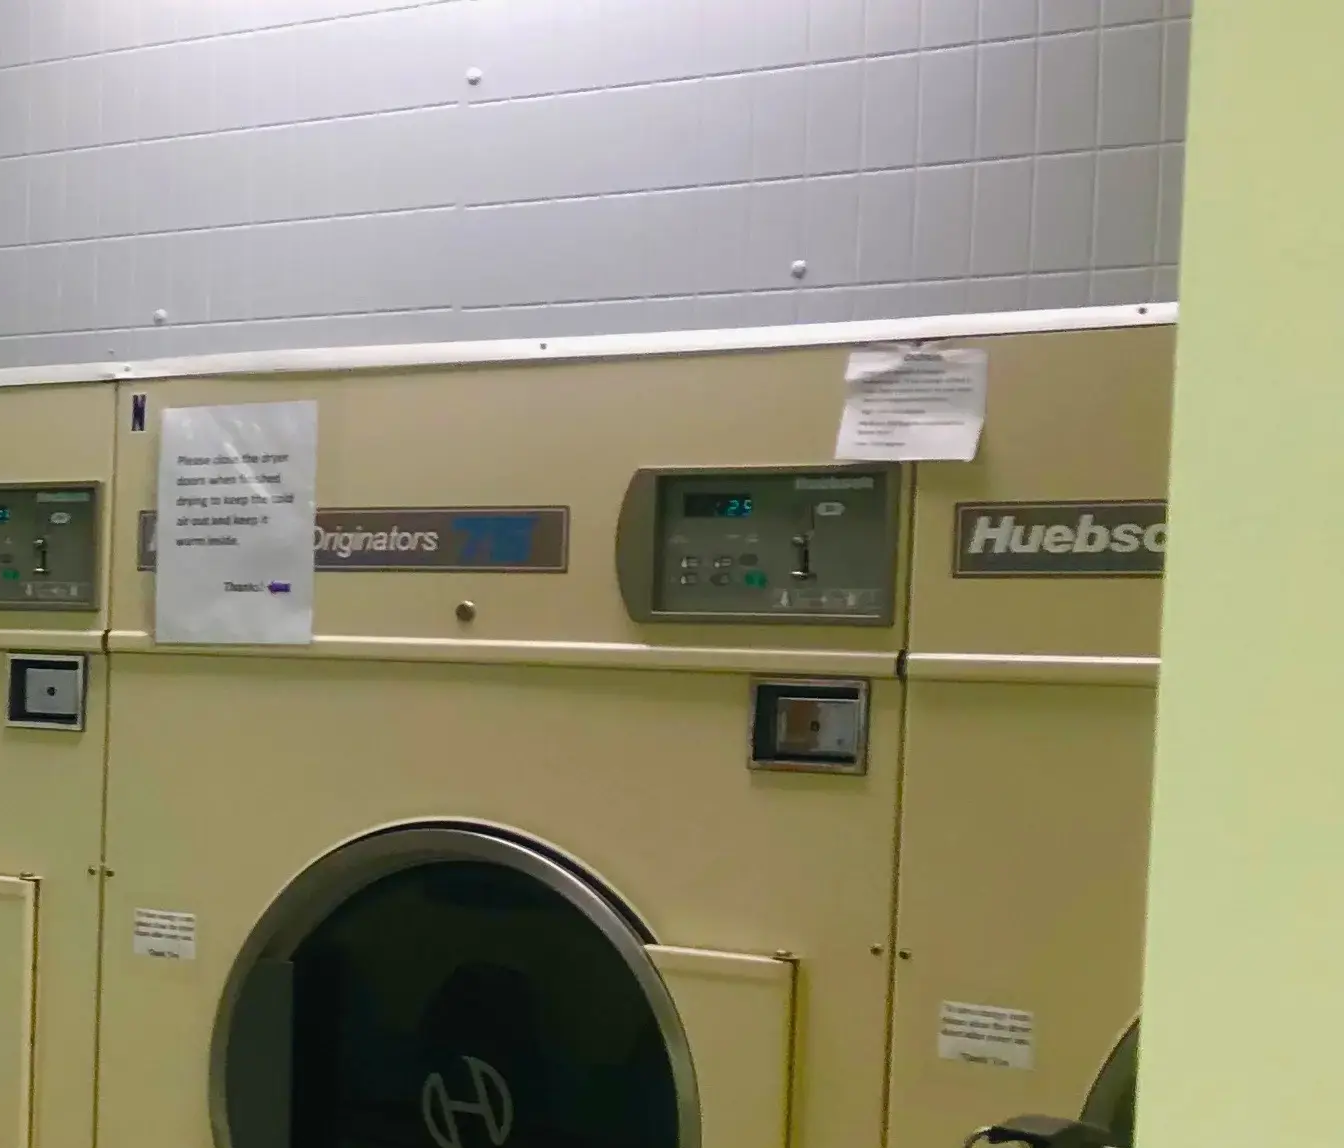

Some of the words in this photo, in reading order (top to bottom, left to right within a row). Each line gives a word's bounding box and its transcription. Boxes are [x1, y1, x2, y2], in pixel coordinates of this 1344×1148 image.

[177, 455, 210, 466] Please
[242, 453, 259, 464] the
[261, 452, 289, 465] dryer
[313, 525, 440, 558] Originators
